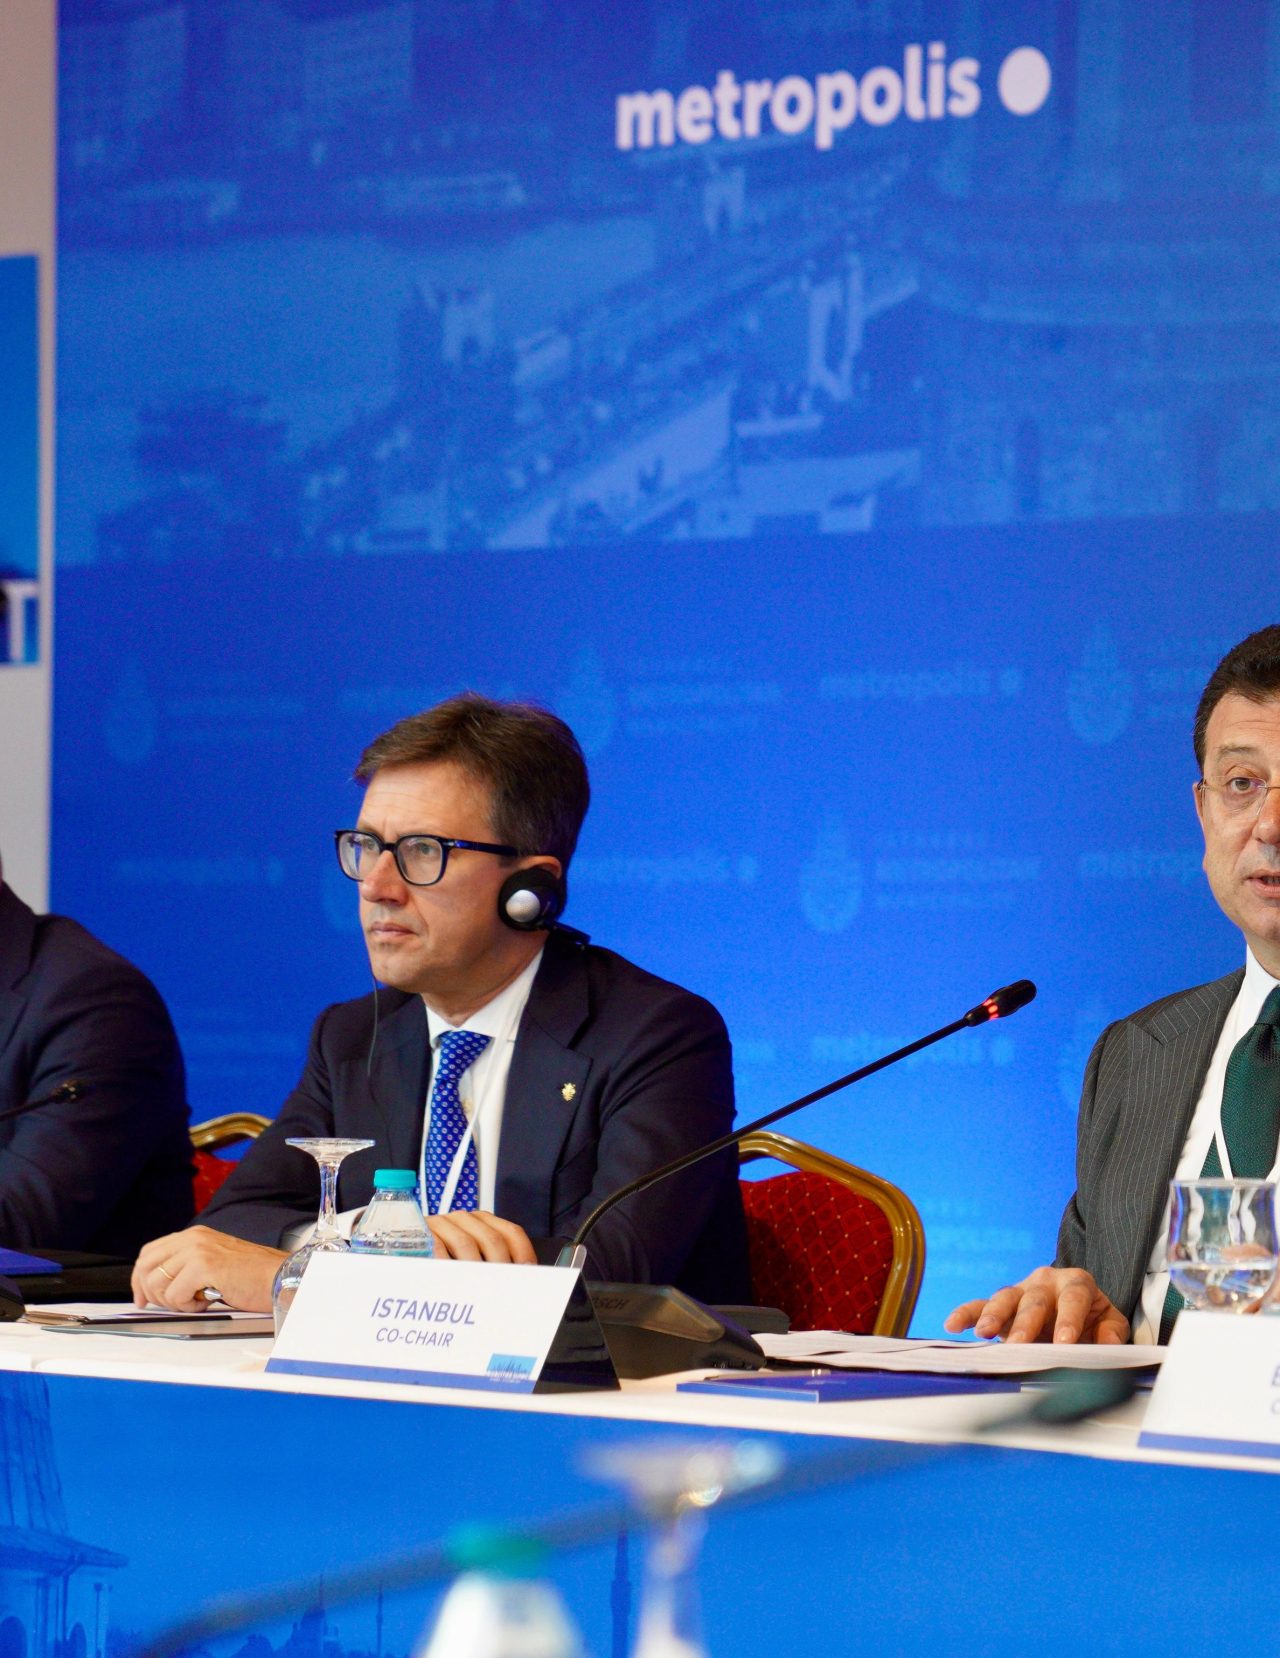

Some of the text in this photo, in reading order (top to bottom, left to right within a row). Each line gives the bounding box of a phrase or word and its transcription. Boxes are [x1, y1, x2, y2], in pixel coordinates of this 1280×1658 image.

[616, 42, 982, 151] metropolis
[370, 1297, 476, 1326] ISTANBUL
[375, 1327, 455, 1348] CO-CHAIR
